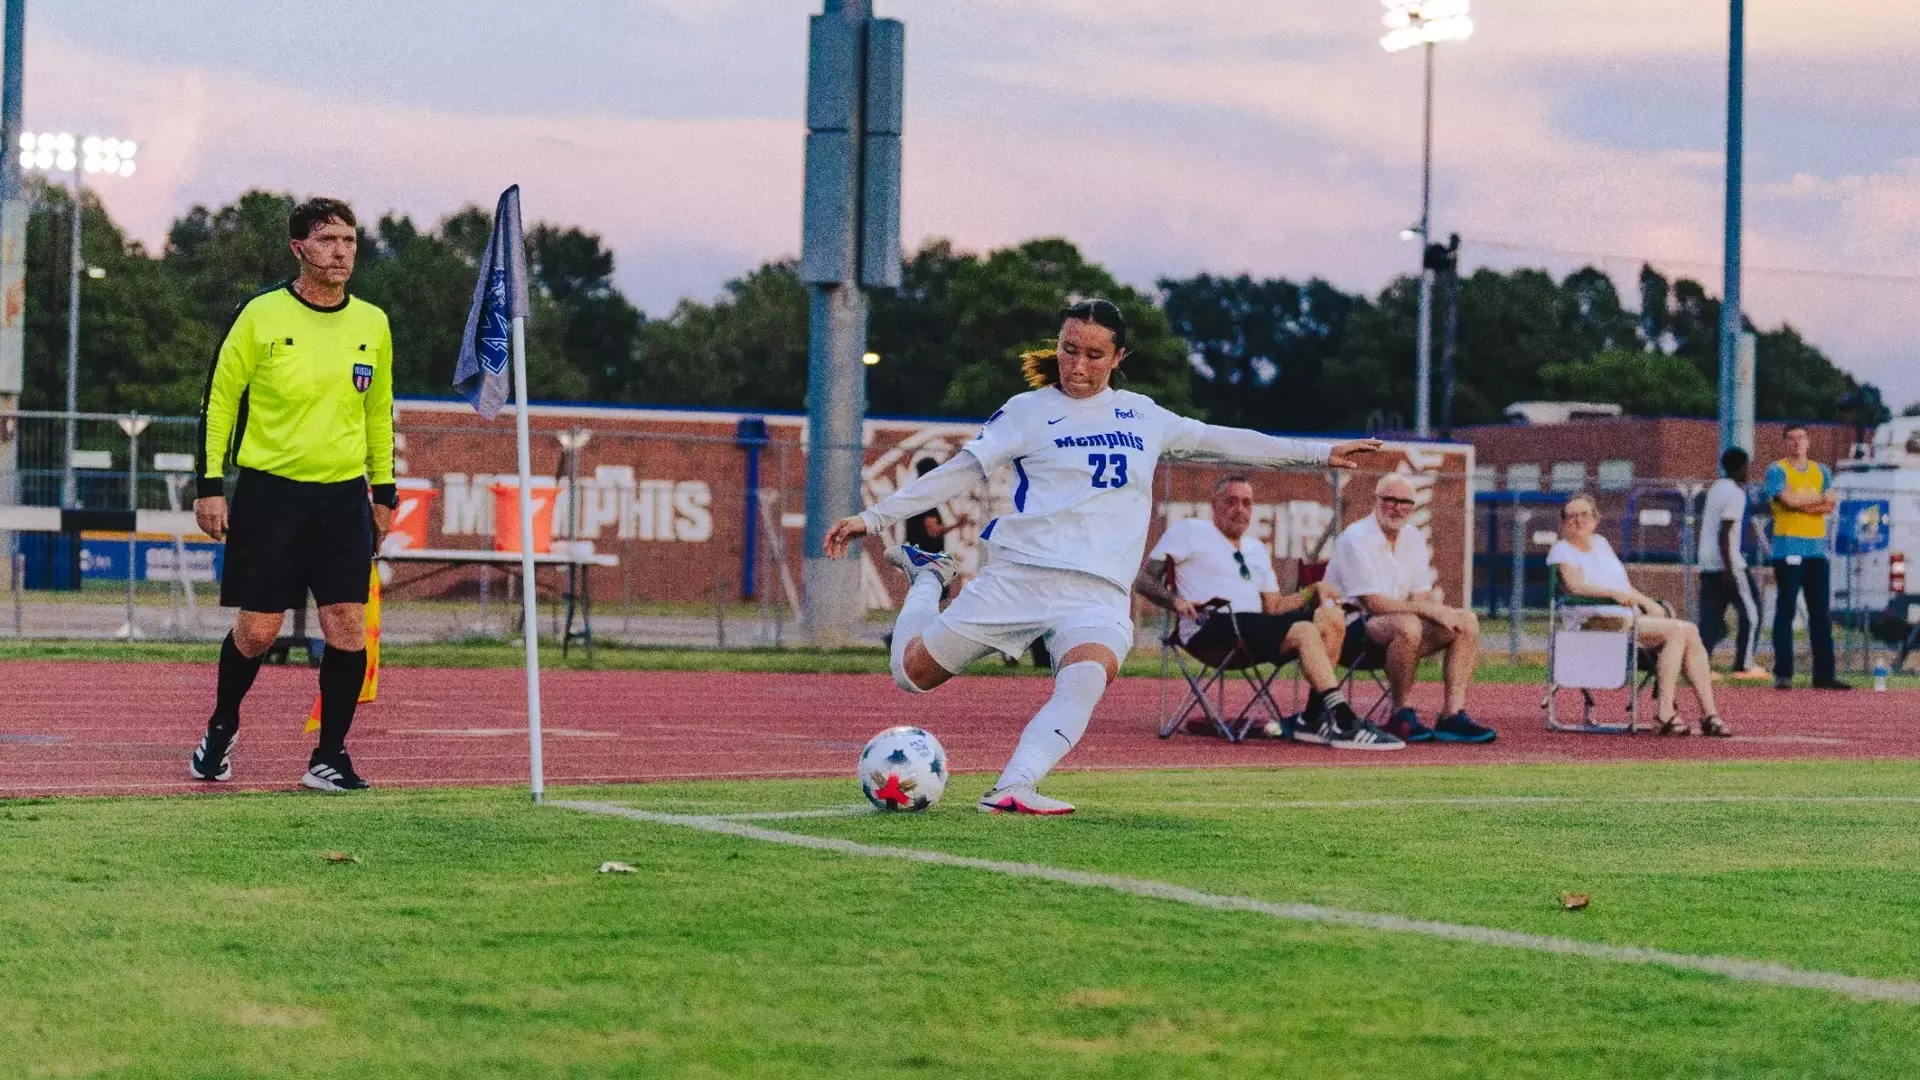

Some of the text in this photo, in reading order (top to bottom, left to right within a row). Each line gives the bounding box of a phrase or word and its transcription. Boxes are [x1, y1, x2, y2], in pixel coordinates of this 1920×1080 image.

[1114, 408, 1145, 419] Fed
[1053, 431, 1144, 451] Memphis
[1088, 453, 1128, 488] 23
[441, 473, 713, 542] MPHIS
